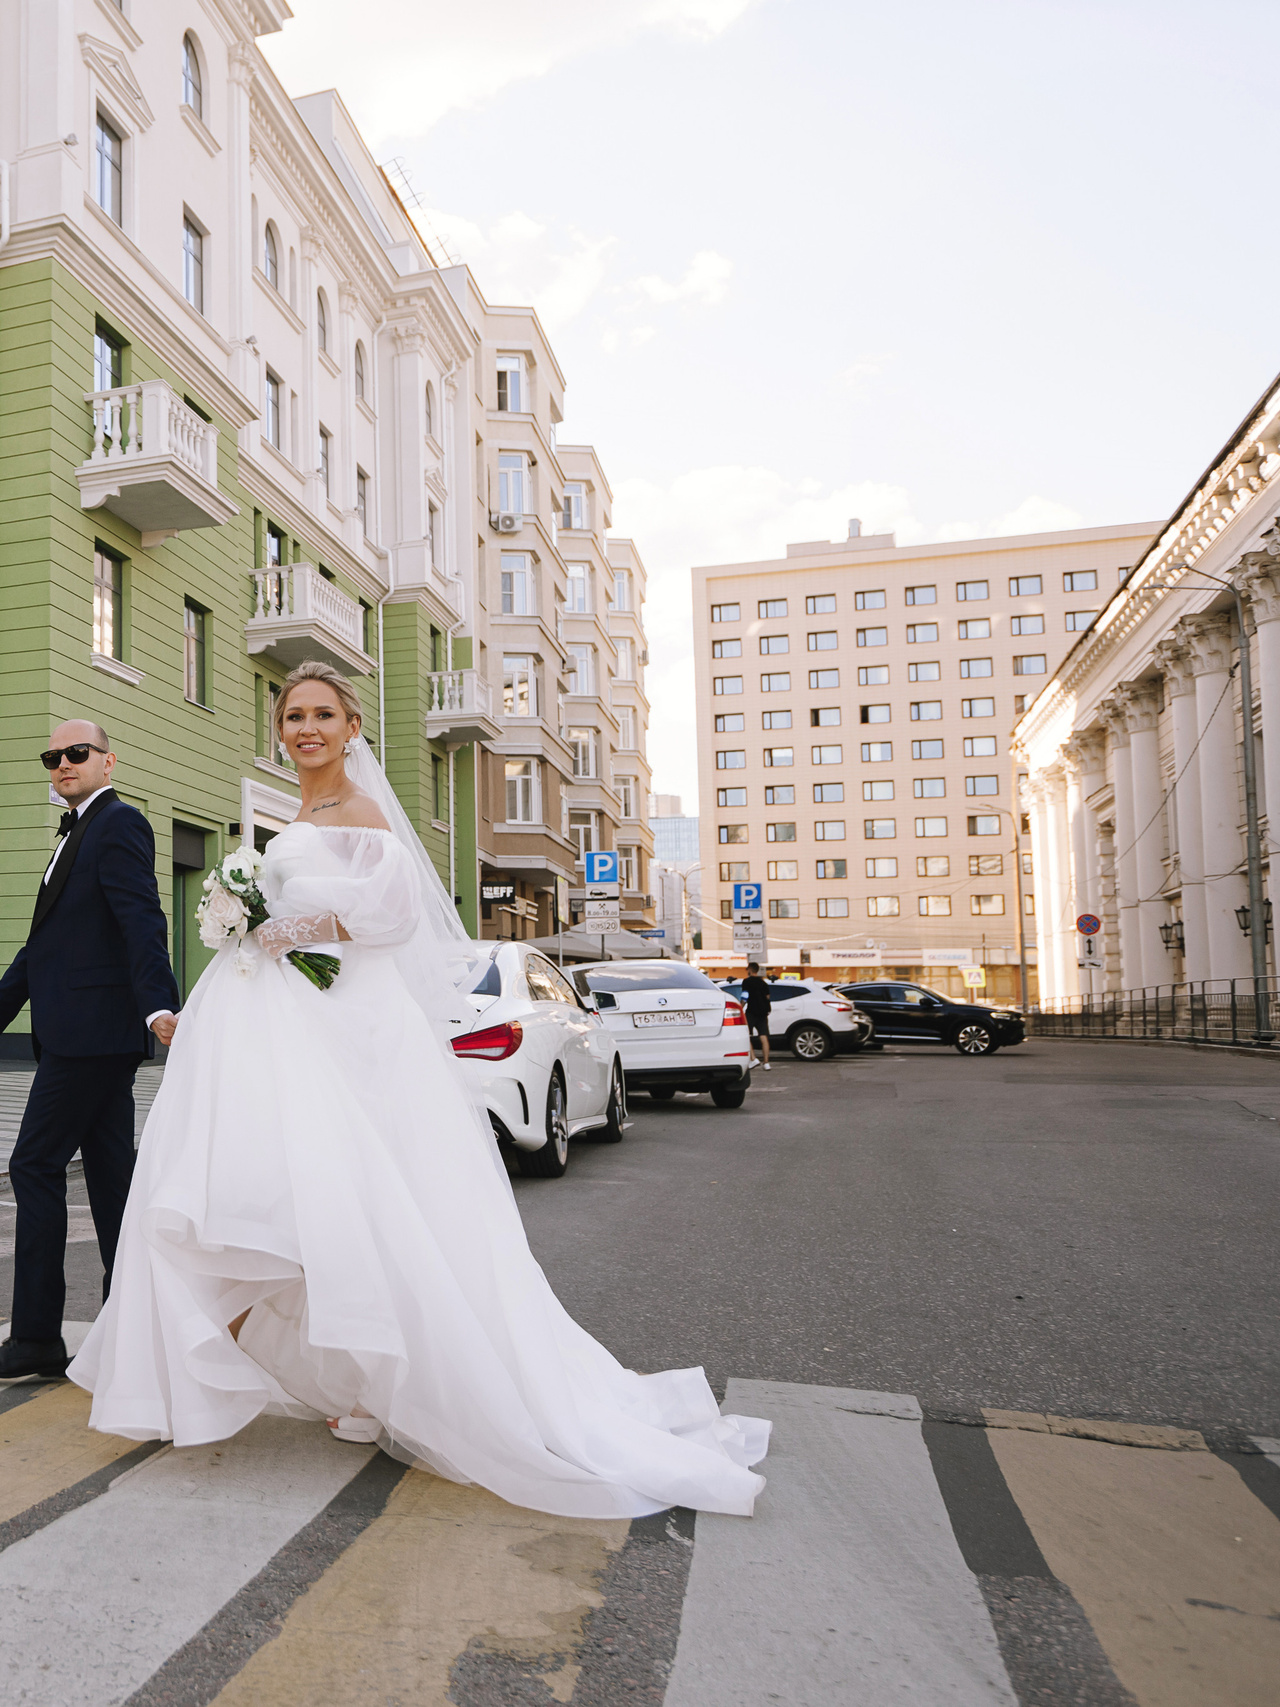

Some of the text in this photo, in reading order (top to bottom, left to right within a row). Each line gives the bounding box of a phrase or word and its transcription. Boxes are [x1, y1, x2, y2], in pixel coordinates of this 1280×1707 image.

[593, 854, 613, 881] P
[740, 885, 758, 908] P
[606, 922, 616, 930] 20
[751, 942, 760, 950] 20
